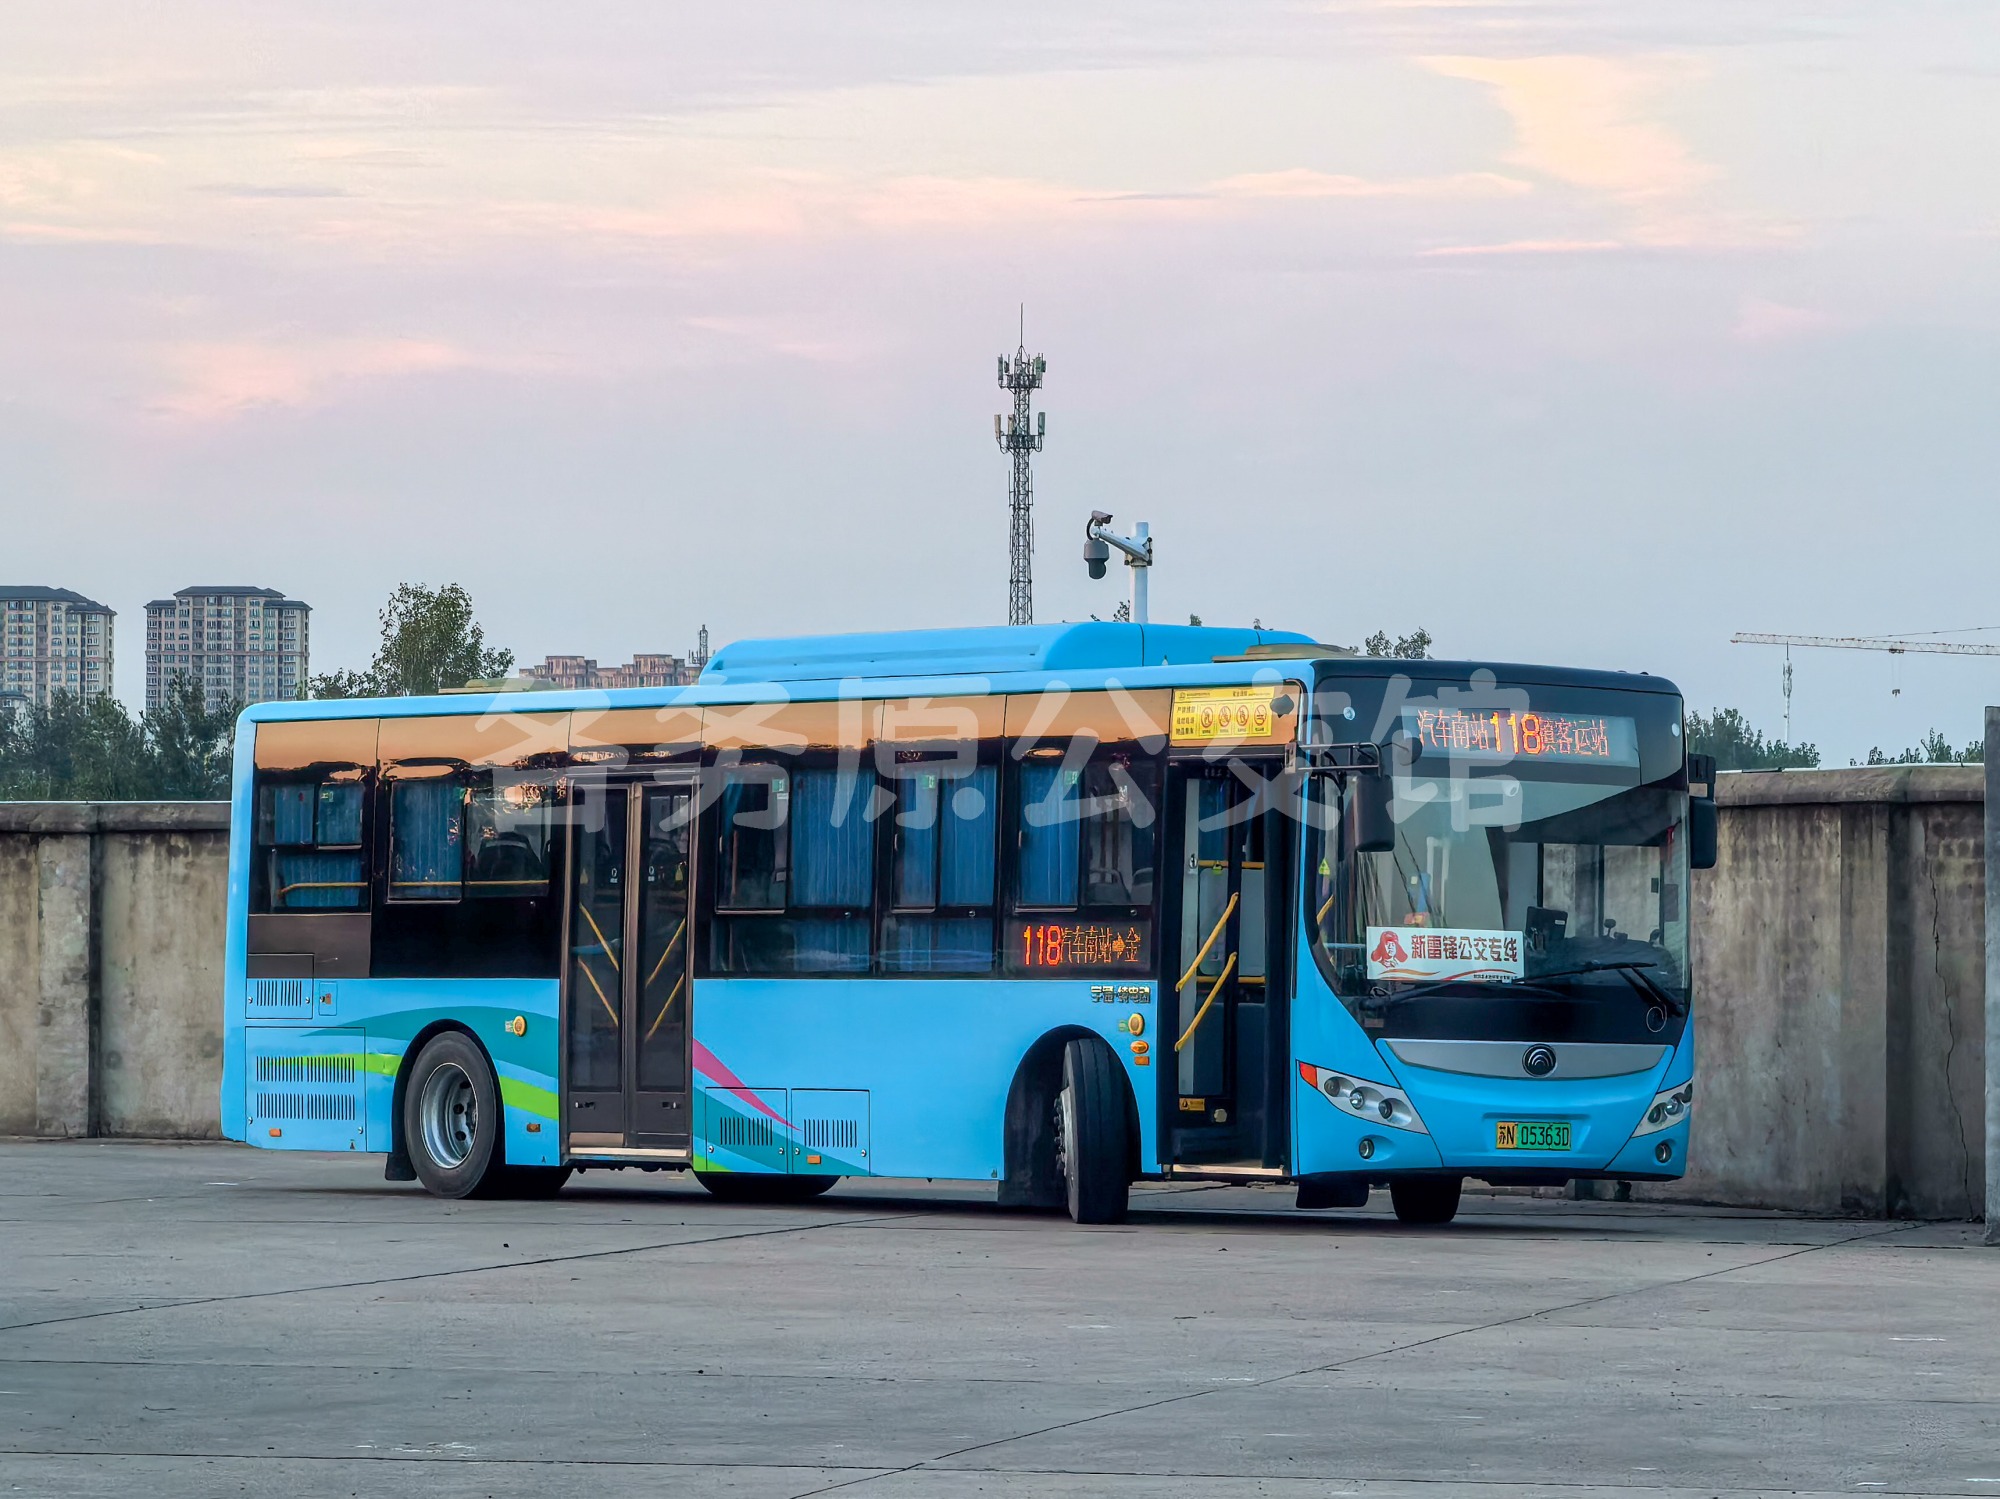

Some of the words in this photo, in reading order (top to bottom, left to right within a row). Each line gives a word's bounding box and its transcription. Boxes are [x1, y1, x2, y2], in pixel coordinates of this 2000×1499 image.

[1417, 708, 1490, 750] 汽车南站
[1490, 711, 1543, 755] 118
[1023, 924, 1062, 966] 118
[1060, 925, 1113, 964] 汽车南站
[1411, 934, 1519, 963] 新雷锋公交专线
